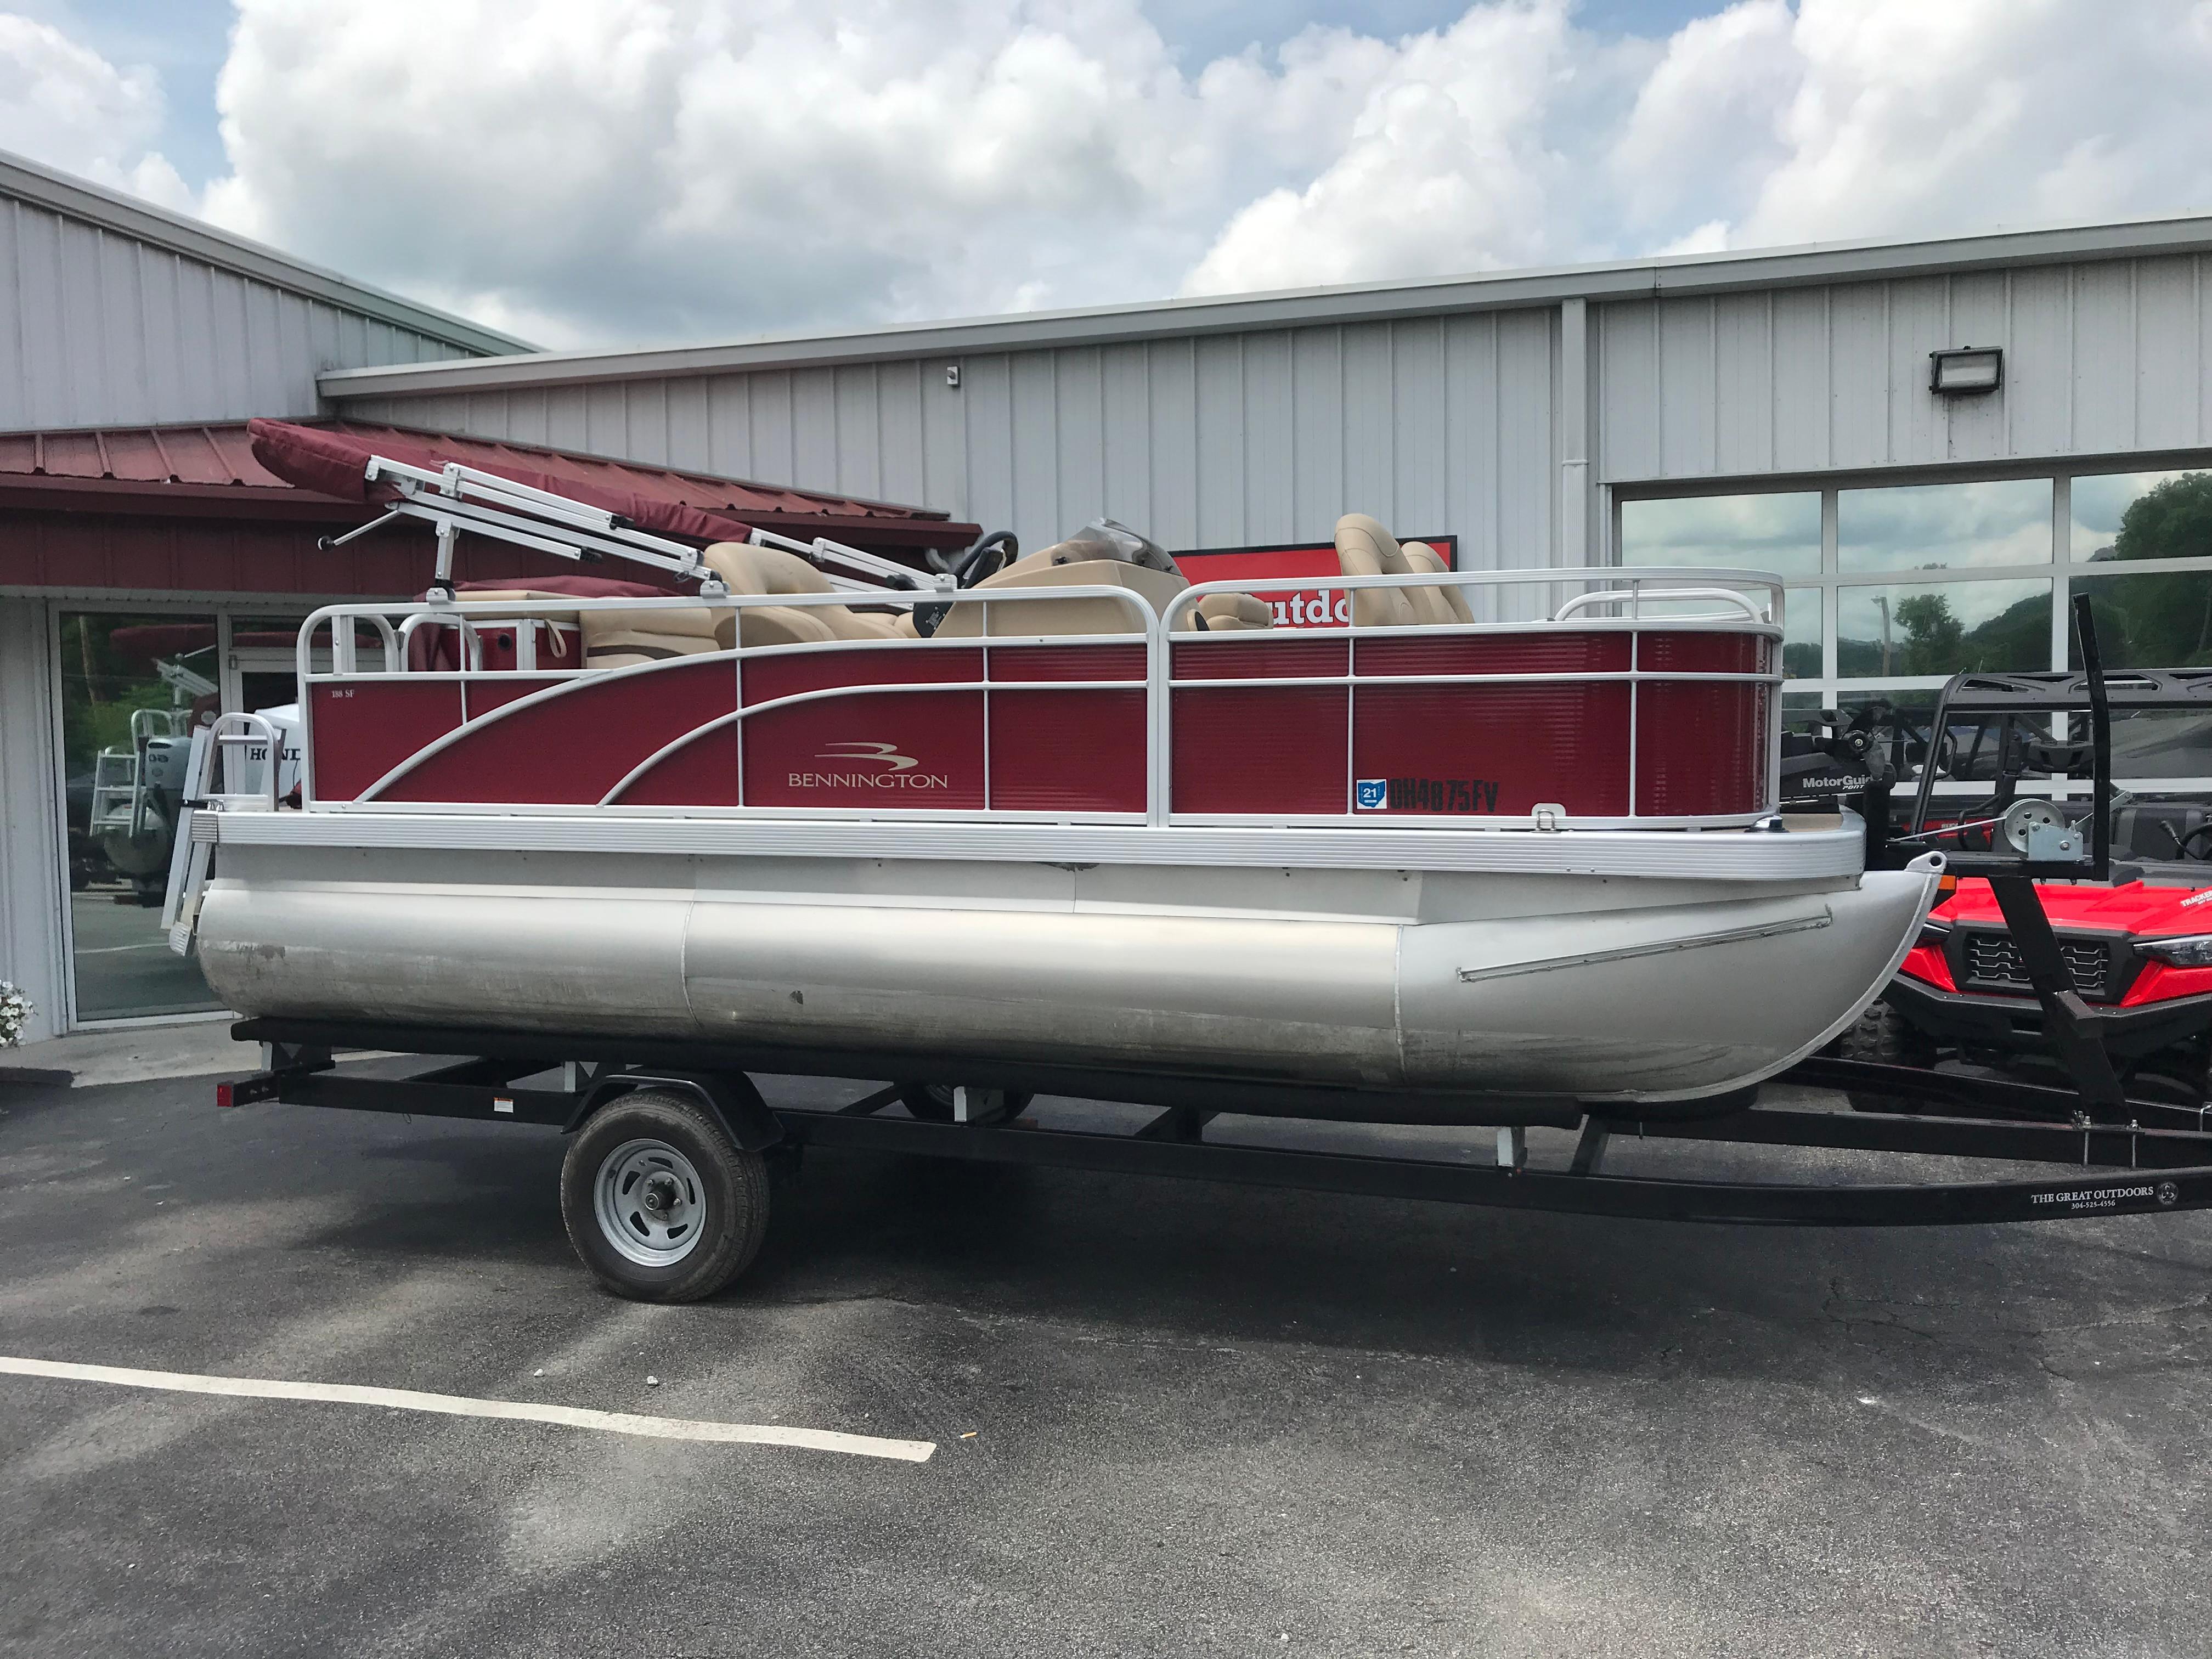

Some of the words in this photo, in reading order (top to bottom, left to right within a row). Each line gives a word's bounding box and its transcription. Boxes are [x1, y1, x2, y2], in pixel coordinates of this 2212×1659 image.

[1265, 590, 1348, 624] utdo
[788, 774, 948, 788] BENNINGTON
[1803, 774, 1882, 788] MotorGuid
[1363, 788, 1376, 798] 21
[2031, 1194, 2054, 1203] THE
[2056, 1191, 2092, 1202] GREAT
[2094, 1187, 2154, 1199] OUTDOORS
[2071, 1199, 2115, 1209] 304-525-4556
